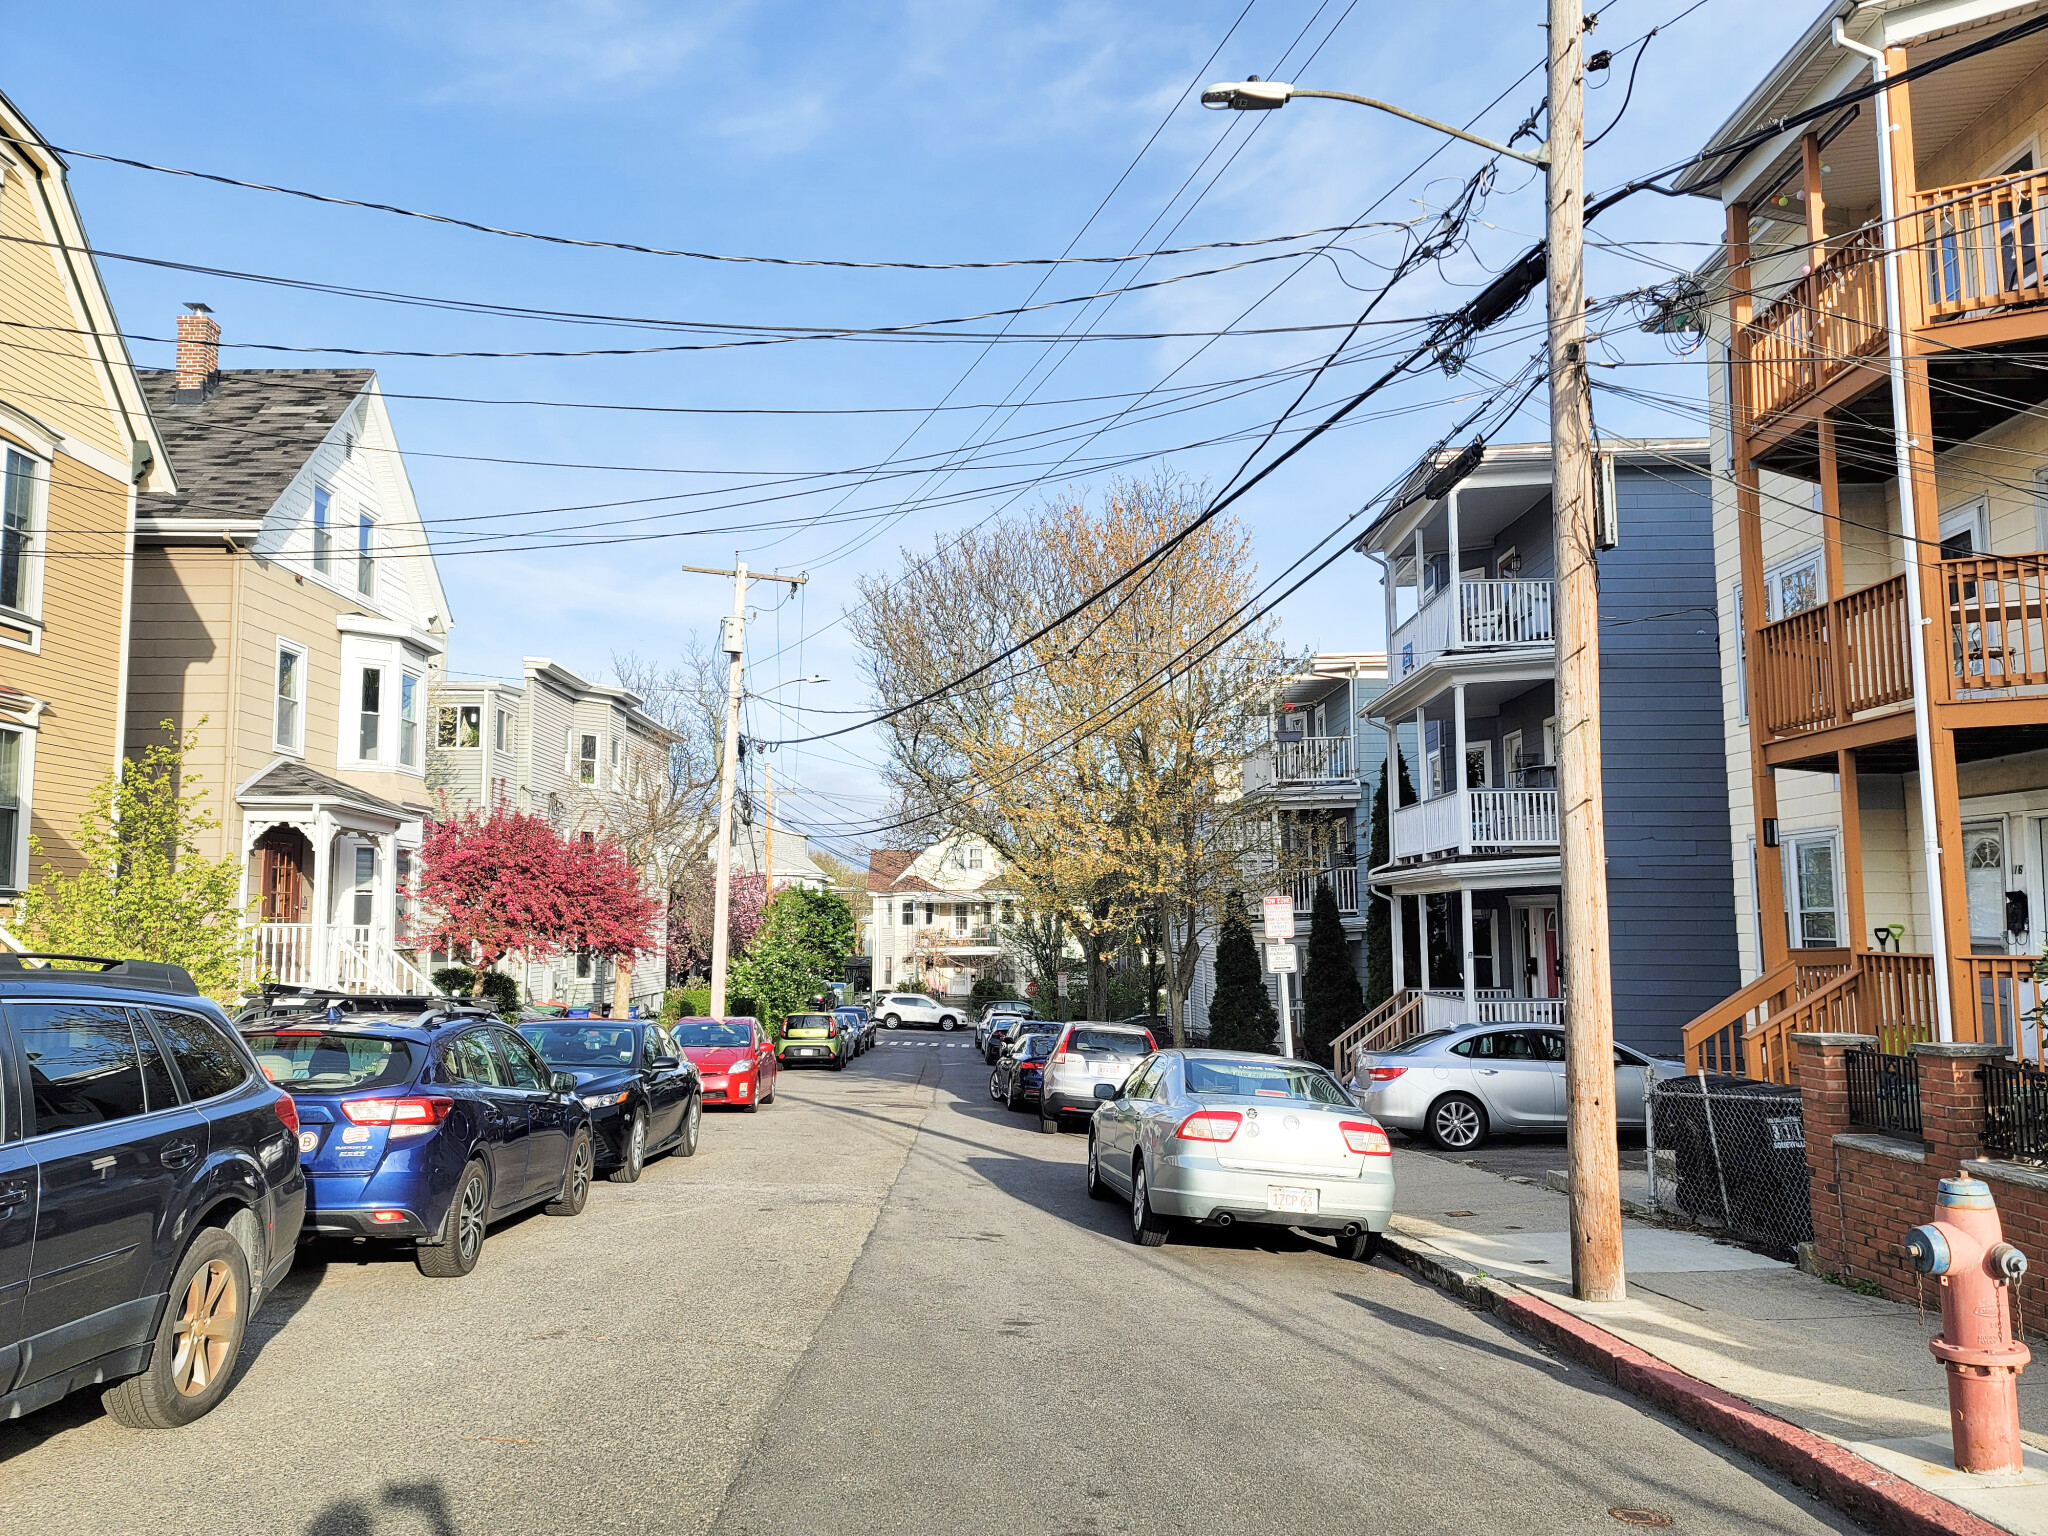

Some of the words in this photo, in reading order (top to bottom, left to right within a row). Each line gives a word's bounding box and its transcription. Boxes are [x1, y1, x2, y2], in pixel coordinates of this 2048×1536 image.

[2014, 865, 2023, 874] 16
[303, 1138, 311, 1146] B
[1273, 1193, 1298, 1207] 1ZCP
[1300, 1195, 1313, 1209] 63
